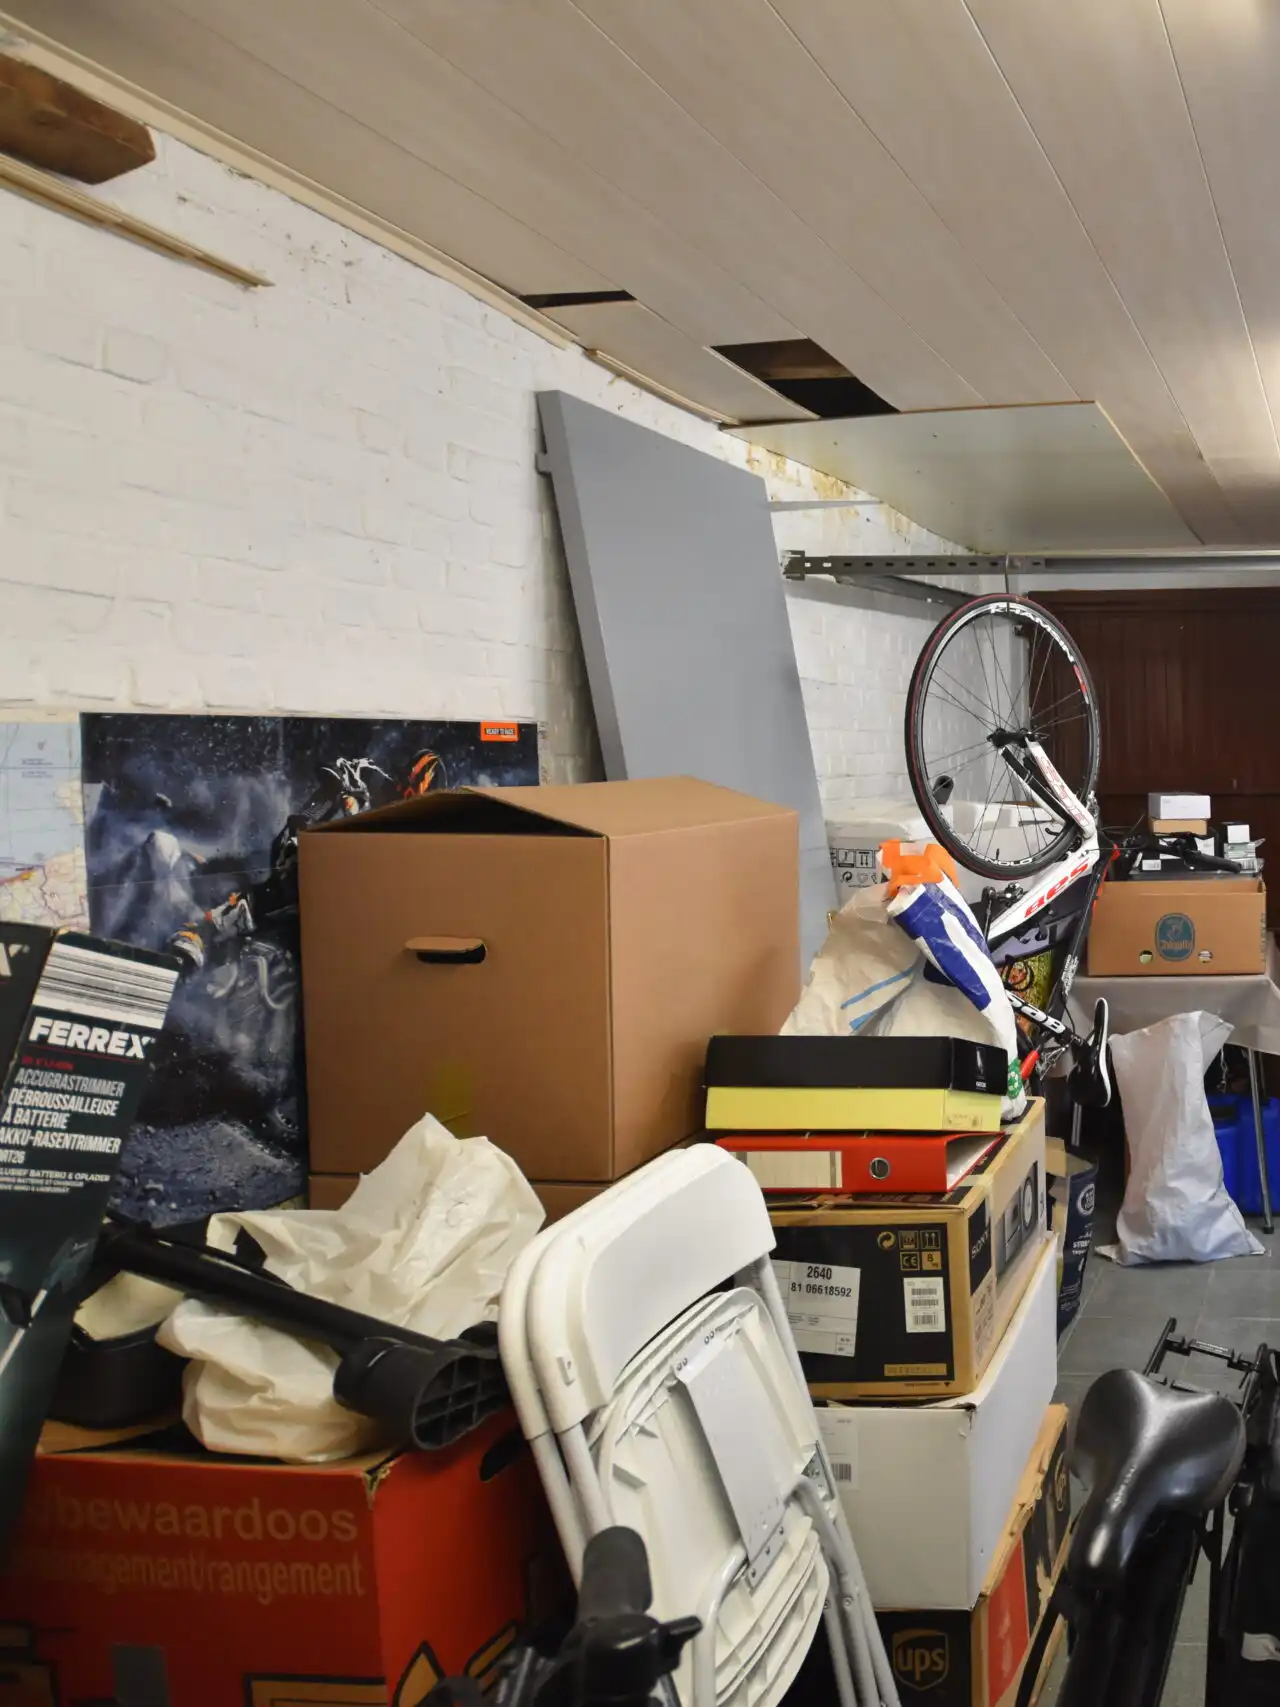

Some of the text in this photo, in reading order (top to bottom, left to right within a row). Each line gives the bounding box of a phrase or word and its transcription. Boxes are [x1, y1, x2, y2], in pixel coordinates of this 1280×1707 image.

[29, 1016, 151, 1060] FERREX
[14, 1067, 125, 1098] ACCUGRASTRIMMER
[8, 1086, 119, 1116] DÉBROUSSAILLEUSE
[13, 1108, 71, 1129] BATTERIE
[74, 1173, 110, 1182] OPLADER
[971, 1226, 990, 1260] SONY
[806, 1265, 832, 1281] 2640
[790, 1282, 852, 1298] 81 06618592
[896, 1645, 947, 1682] ups
